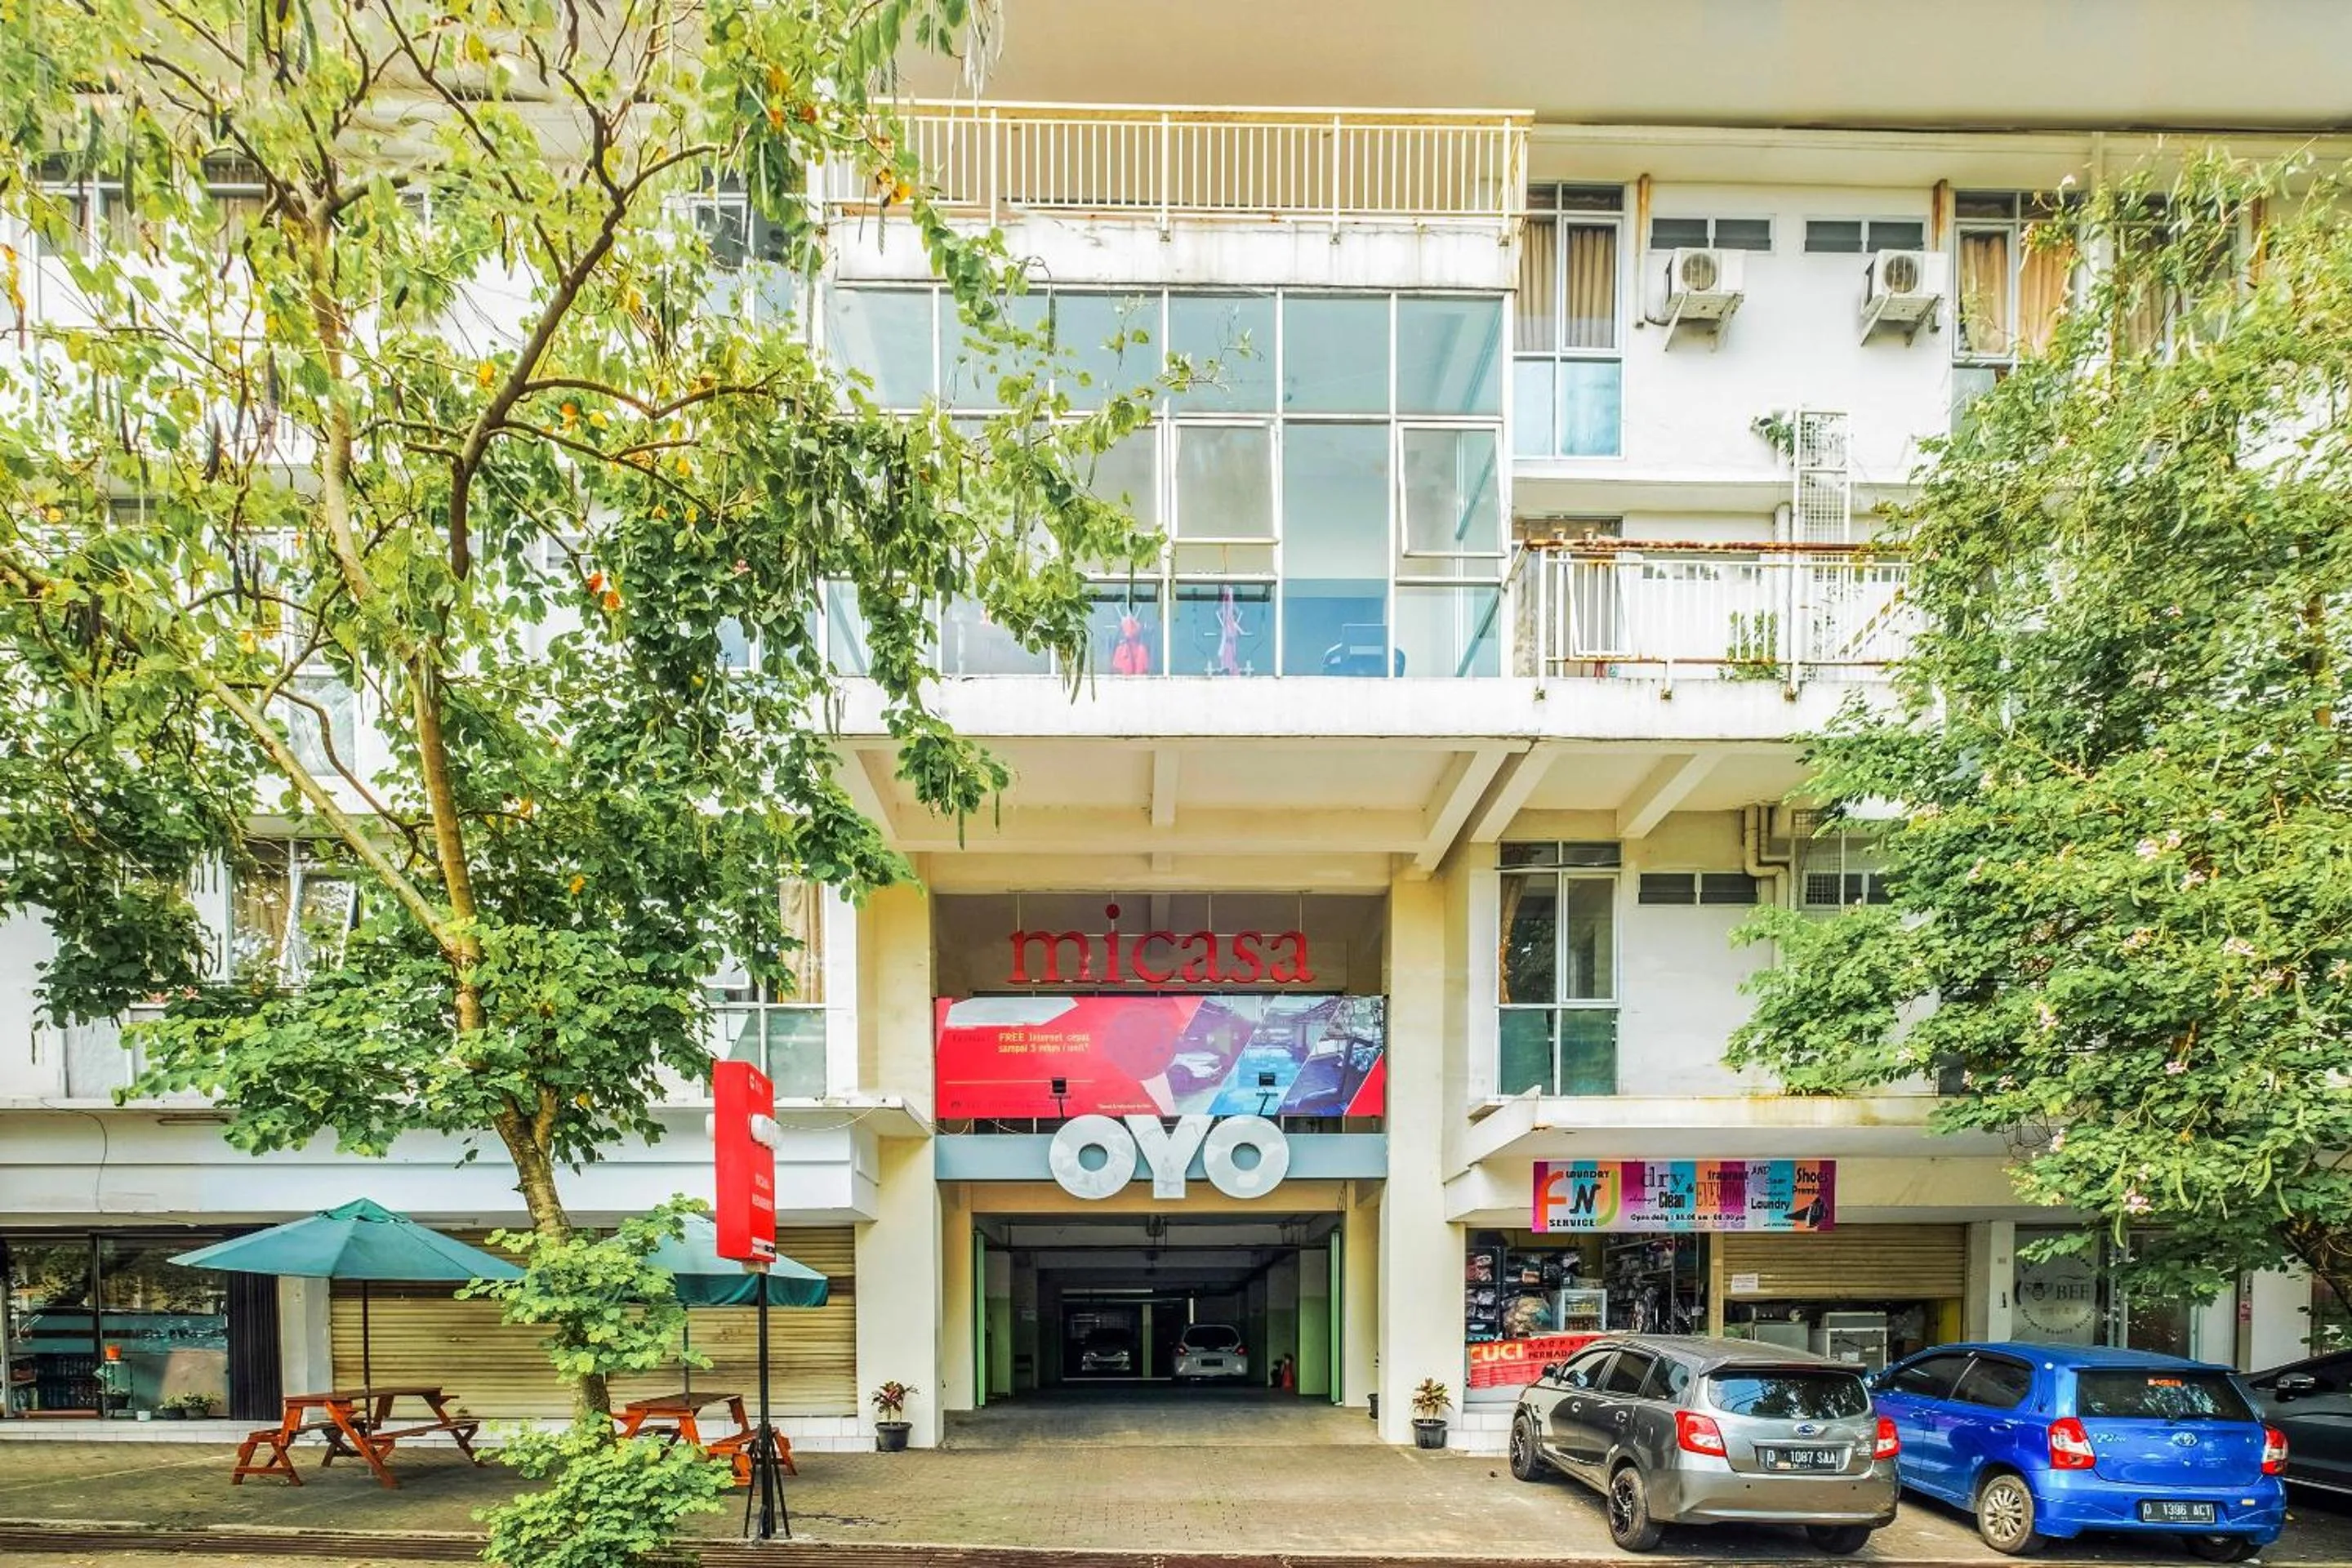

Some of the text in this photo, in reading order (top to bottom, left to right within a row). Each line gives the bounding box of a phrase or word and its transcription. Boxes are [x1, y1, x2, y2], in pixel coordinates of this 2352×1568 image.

[1007, 903, 1316, 985] micasa
[999, 1033, 1025, 1042] FREE
[1049, 1114, 1290, 1199] OYO
[1641, 1166, 1685, 1193] dry
[1797, 1167, 1830, 1183] Shoes
[1659, 1192, 1686, 1209] Clean
[1751, 1197, 1790, 1210] Laundry
[1548, 1218, 1595, 1227] SERVICE
[1630, 1214, 1650, 1222] Open
[1651, 1214, 1669, 1222] daily
[1470, 1342, 1524, 1364] CUCI
[1529, 1349, 1574, 1359] PERMADA
[1791, 1450, 1813, 1463] 1087
[1817, 1451, 1836, 1463] SAA
[2163, 1503, 2187, 1516] 1396
